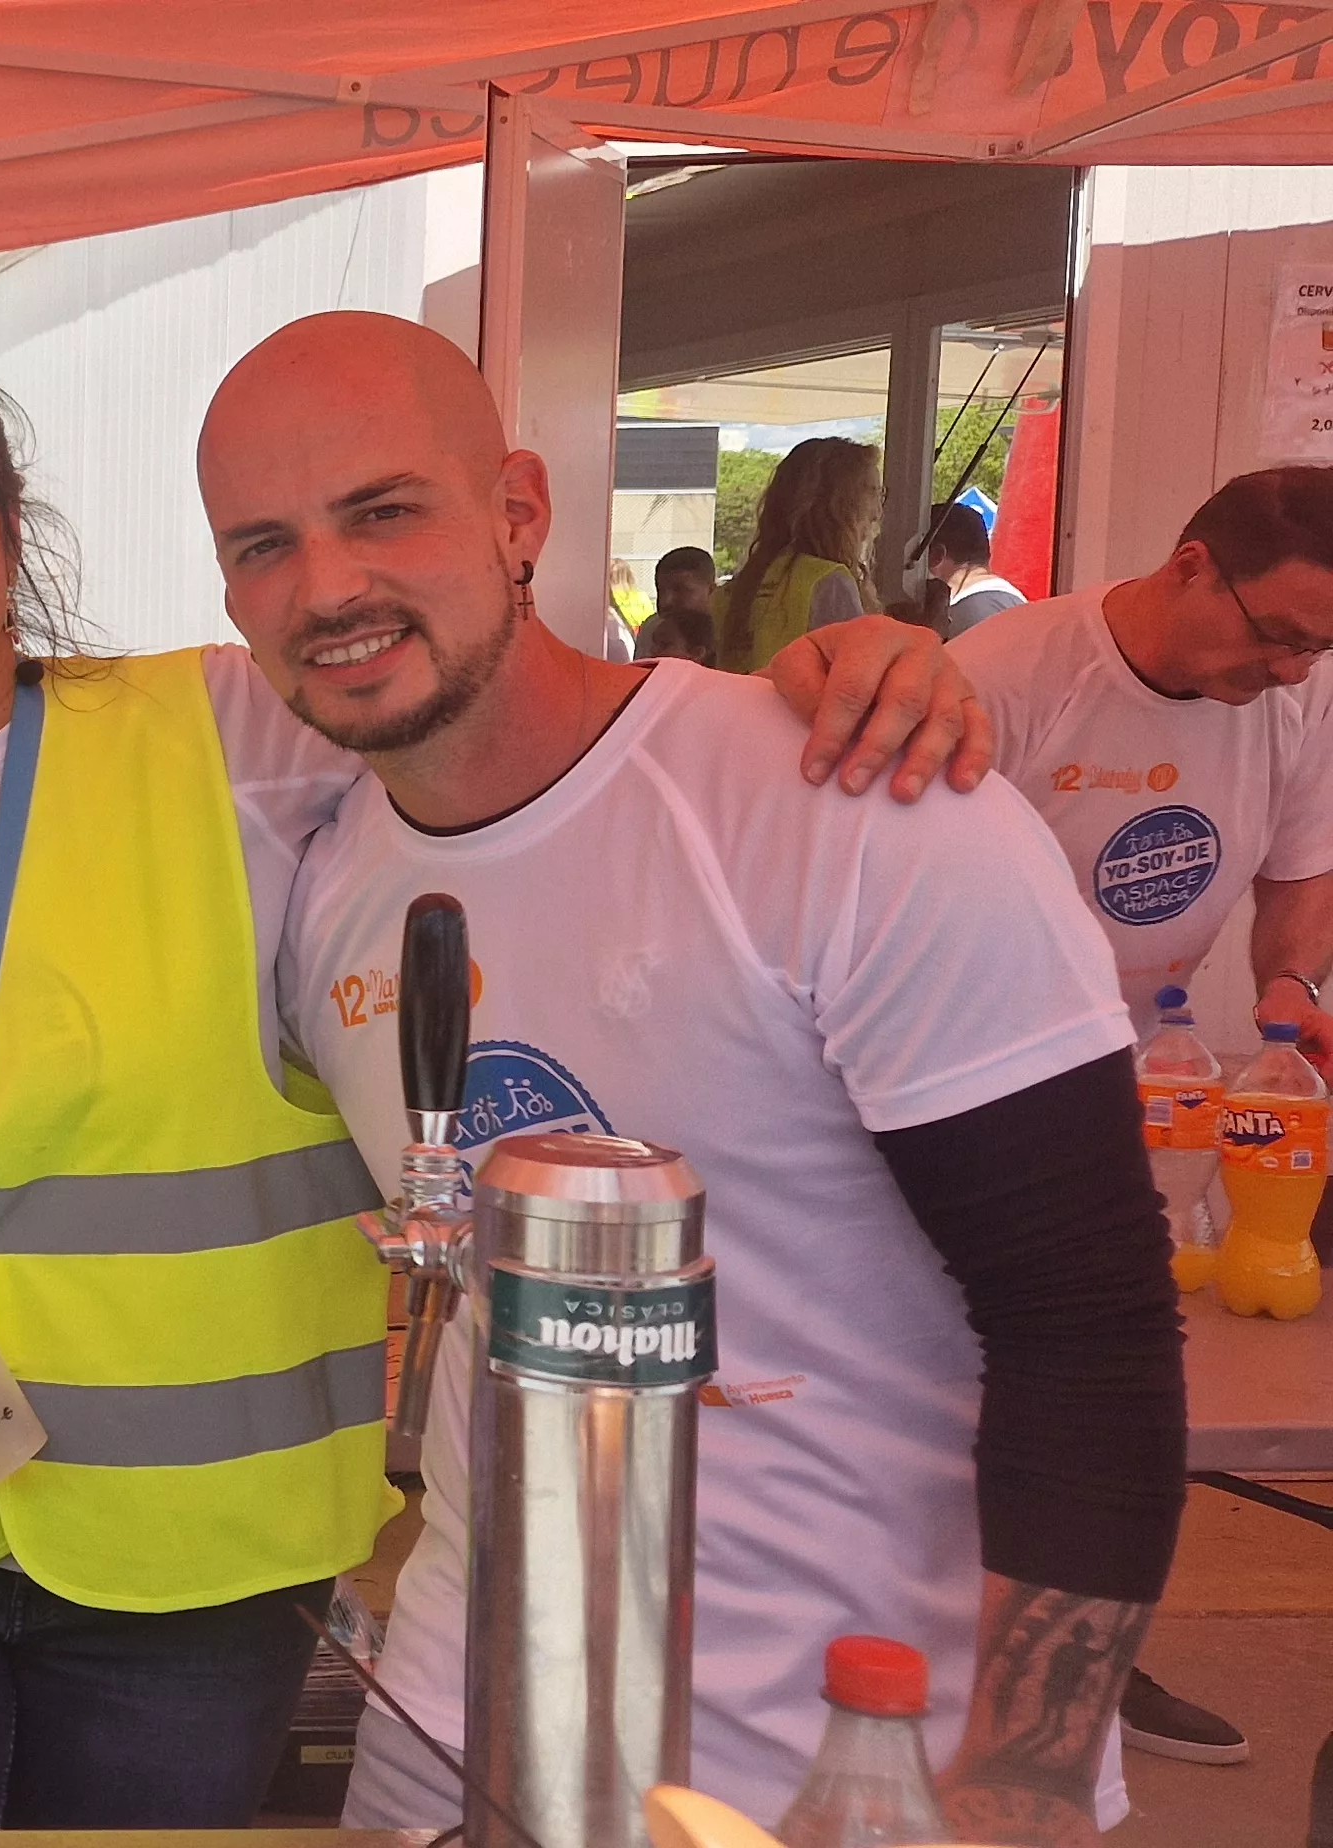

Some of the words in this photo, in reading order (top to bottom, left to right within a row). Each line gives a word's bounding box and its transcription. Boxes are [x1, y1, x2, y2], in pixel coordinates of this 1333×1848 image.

[1113, 869, 1200, 903] ASPACE
[1123, 889, 1191, 913] Huesca
[538, 1317, 697, 1367] Mahou
